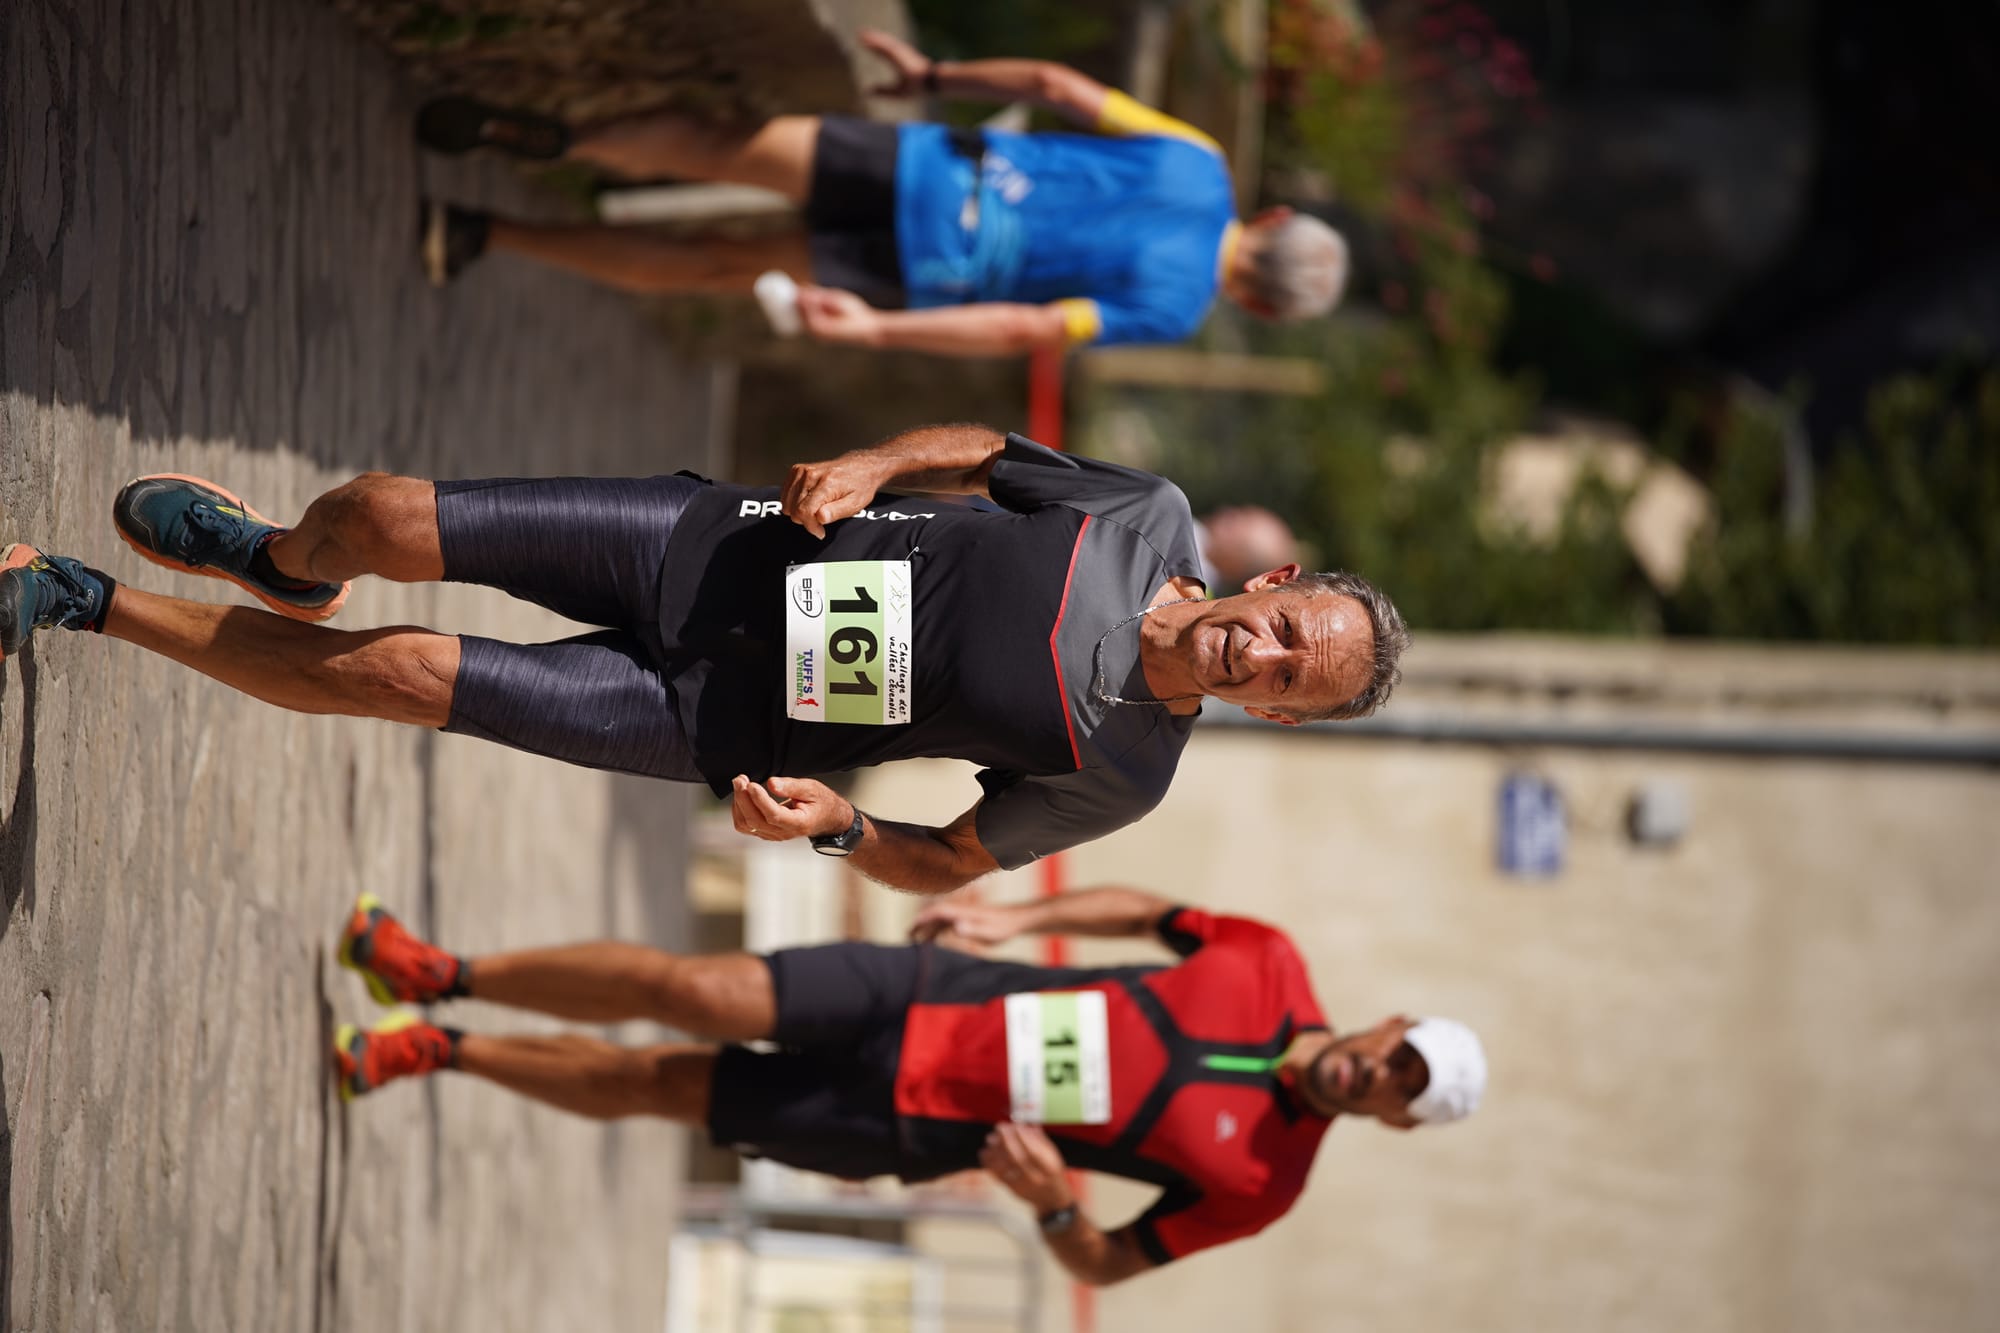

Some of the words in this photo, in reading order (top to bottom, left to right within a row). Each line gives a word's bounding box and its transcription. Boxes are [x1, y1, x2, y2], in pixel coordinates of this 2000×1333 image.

[802, 577, 812, 612] BFP
[829, 586, 878, 696] 161
[889, 636, 898, 673] vallées
[796, 652, 805, 698] Aventure
[803, 648, 813, 694] TUFF'S
[896, 642, 908, 694] Challenge
[889, 678, 897, 719] cévenoles
[899, 699, 907, 715] des
[1045, 1027, 1079, 1086] 15
